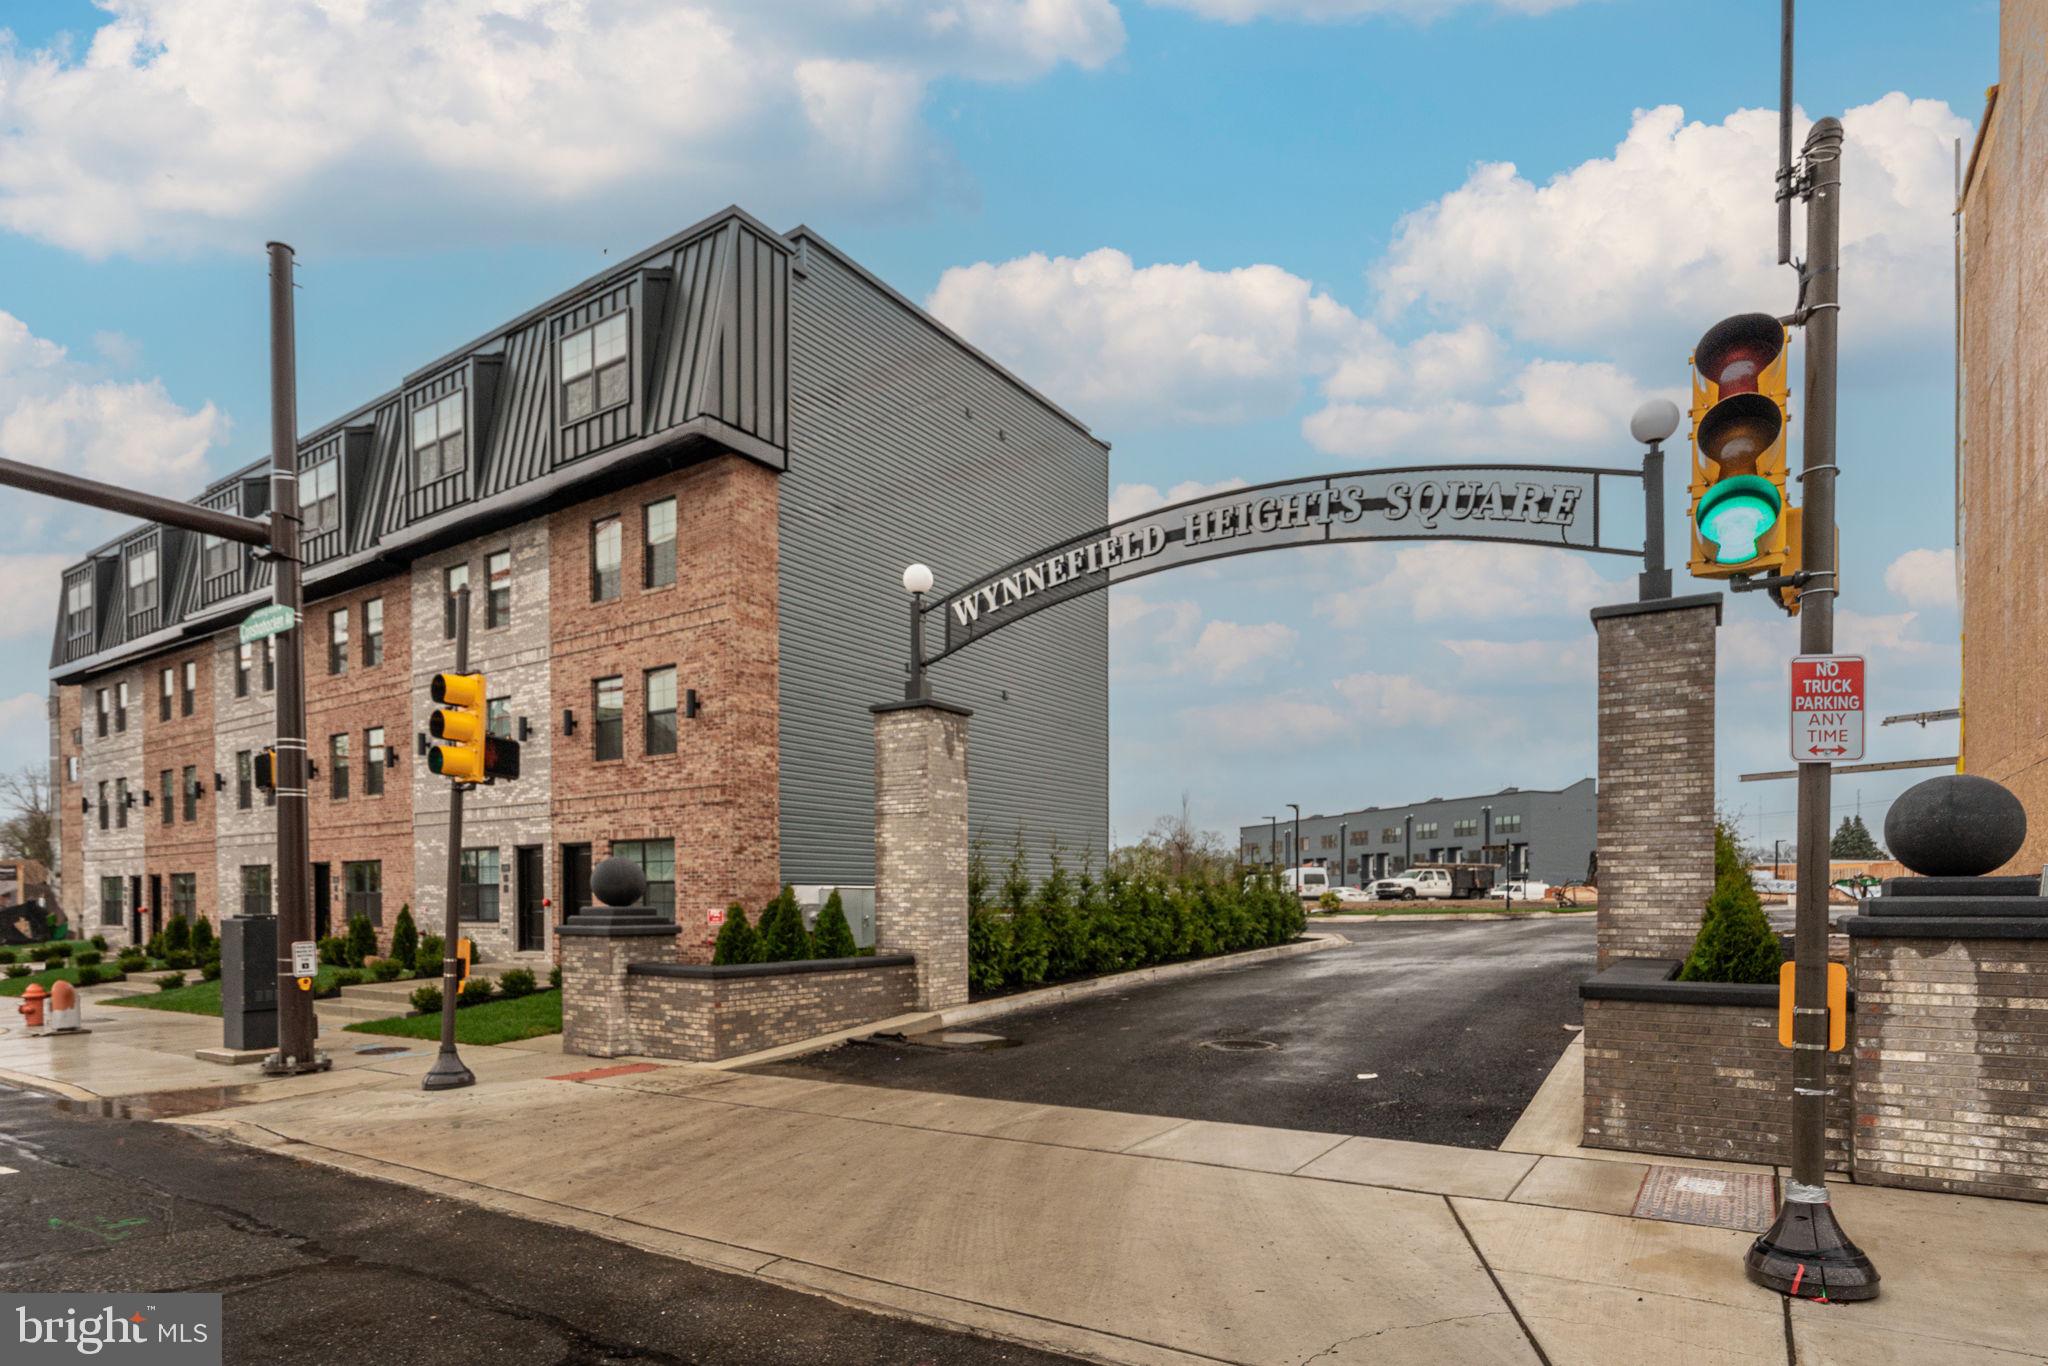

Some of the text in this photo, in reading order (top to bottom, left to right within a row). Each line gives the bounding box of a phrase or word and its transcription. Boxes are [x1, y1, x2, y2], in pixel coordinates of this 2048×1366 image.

[951, 480, 1583, 627] WYNNEFIELD HEIGHTS SQUARE
[1816, 662, 1839, 677] NO
[1803, 679, 1852, 693] TRUCK
[1795, 695, 1860, 710] PARKING
[1809, 713, 1847, 726] ANY
[1807, 729, 1848, 742] TIME
